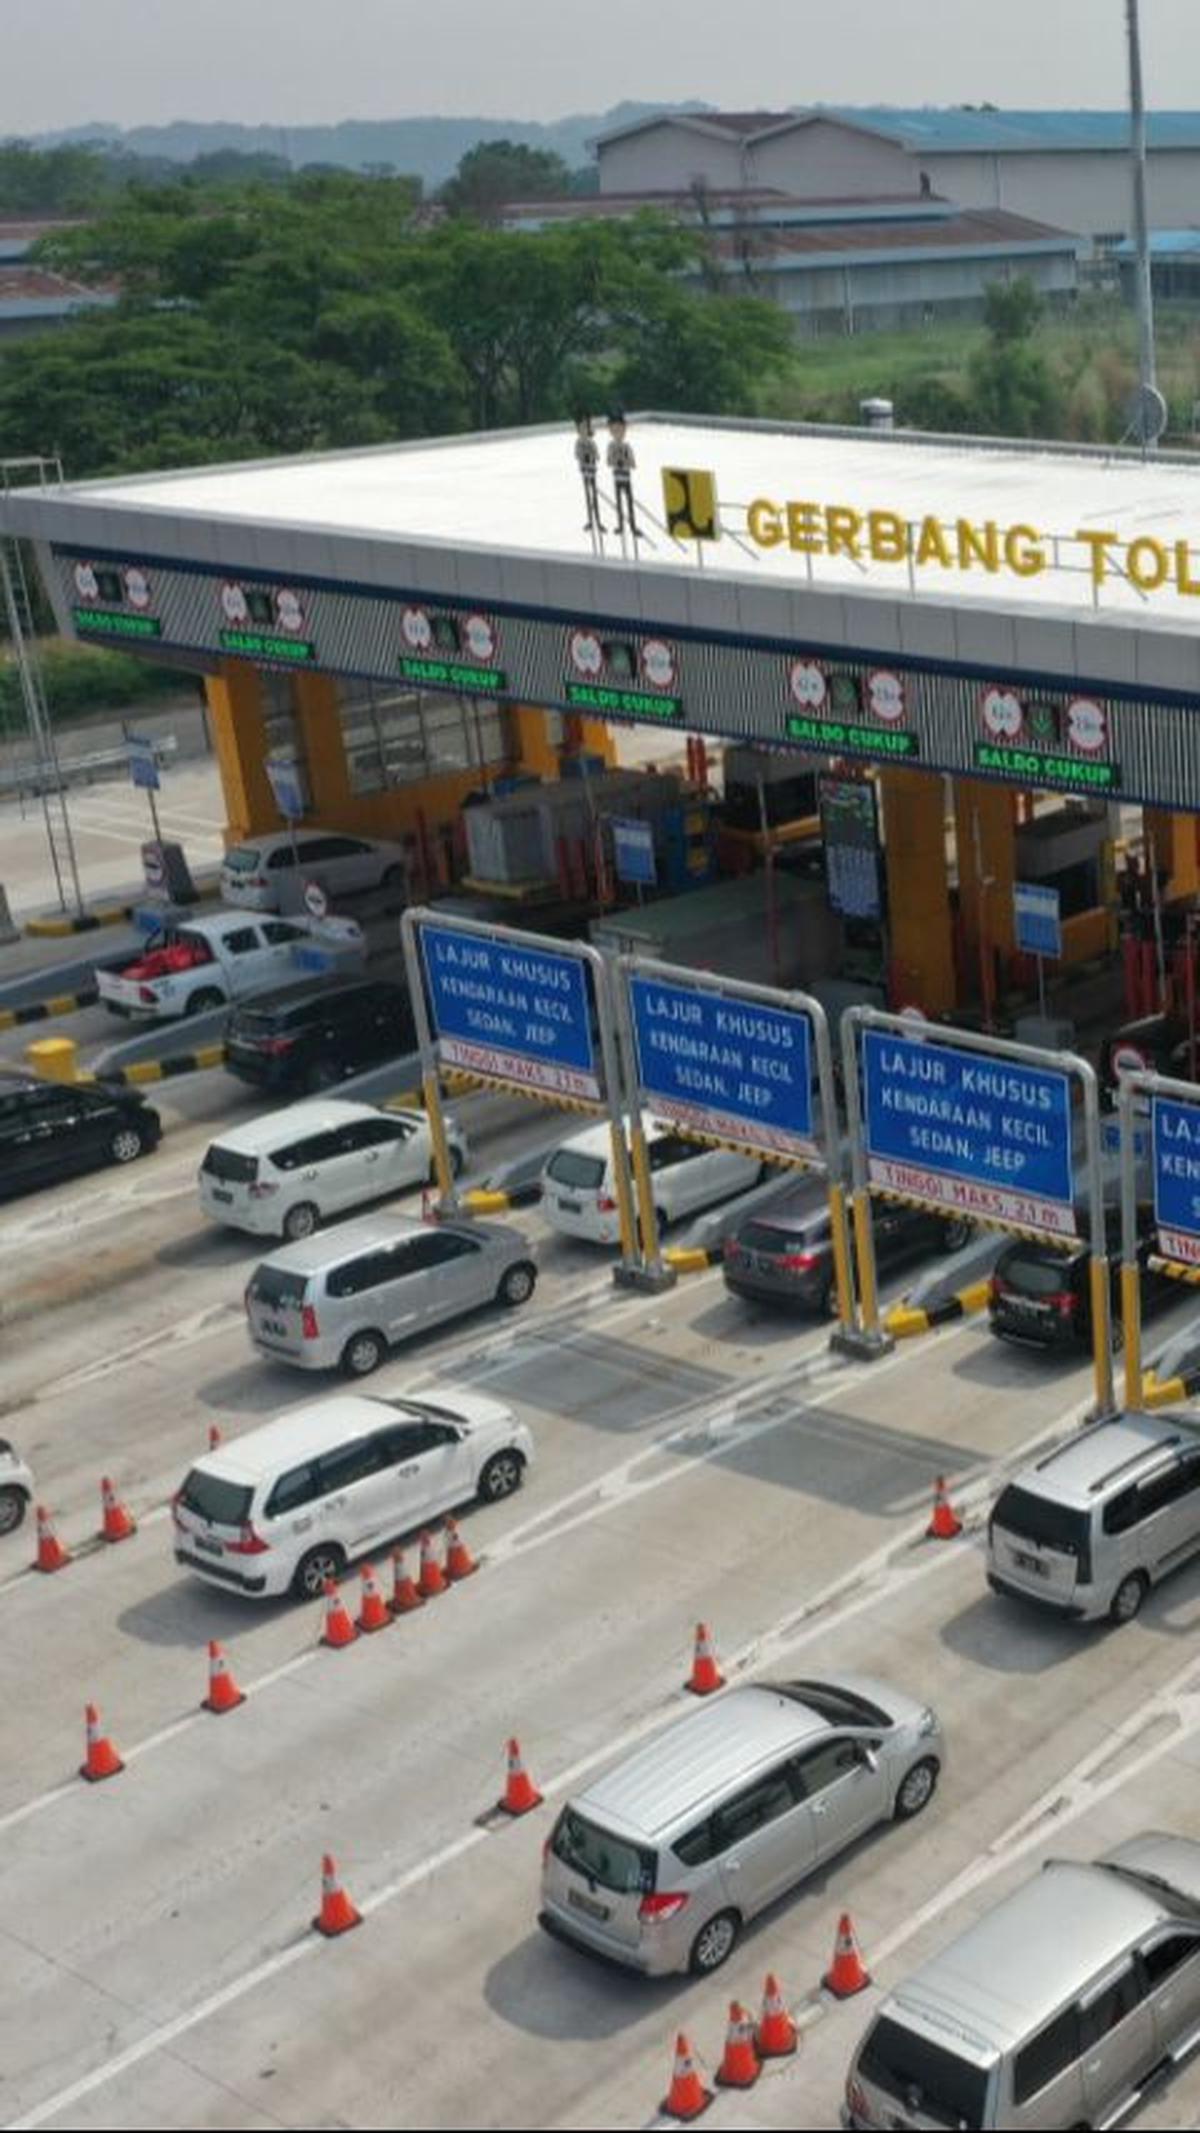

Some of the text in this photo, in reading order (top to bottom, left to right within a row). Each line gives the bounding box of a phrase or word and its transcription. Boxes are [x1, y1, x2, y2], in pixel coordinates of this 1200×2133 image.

[747, 498, 1200, 596] GERBANG TOL
[570, 687, 618, 706] SALDO
[790, 718, 911, 751] SALDO CUKUP
[979, 749, 1111, 783] SALDO CUKUP
[436, 943, 571, 991] LAJUR KHUSUS
[440, 978, 528, 1011] KENDARAAN
[526, 1026, 557, 1043] JEEP
[646, 996, 793, 1048] LAJUR KHUSUS
[651, 1032, 793, 1084] KENDARAAN KECIL
[739, 1084, 772, 1106] JEEP
[880, 1051, 1052, 1108] LAJUR KHUSUS
[882, 1088, 1050, 1146] KENDARAAN KECIL
[910, 1127, 1026, 1170] SEDAN, JEEP
[886, 1167, 939, 1195] TINGGI
